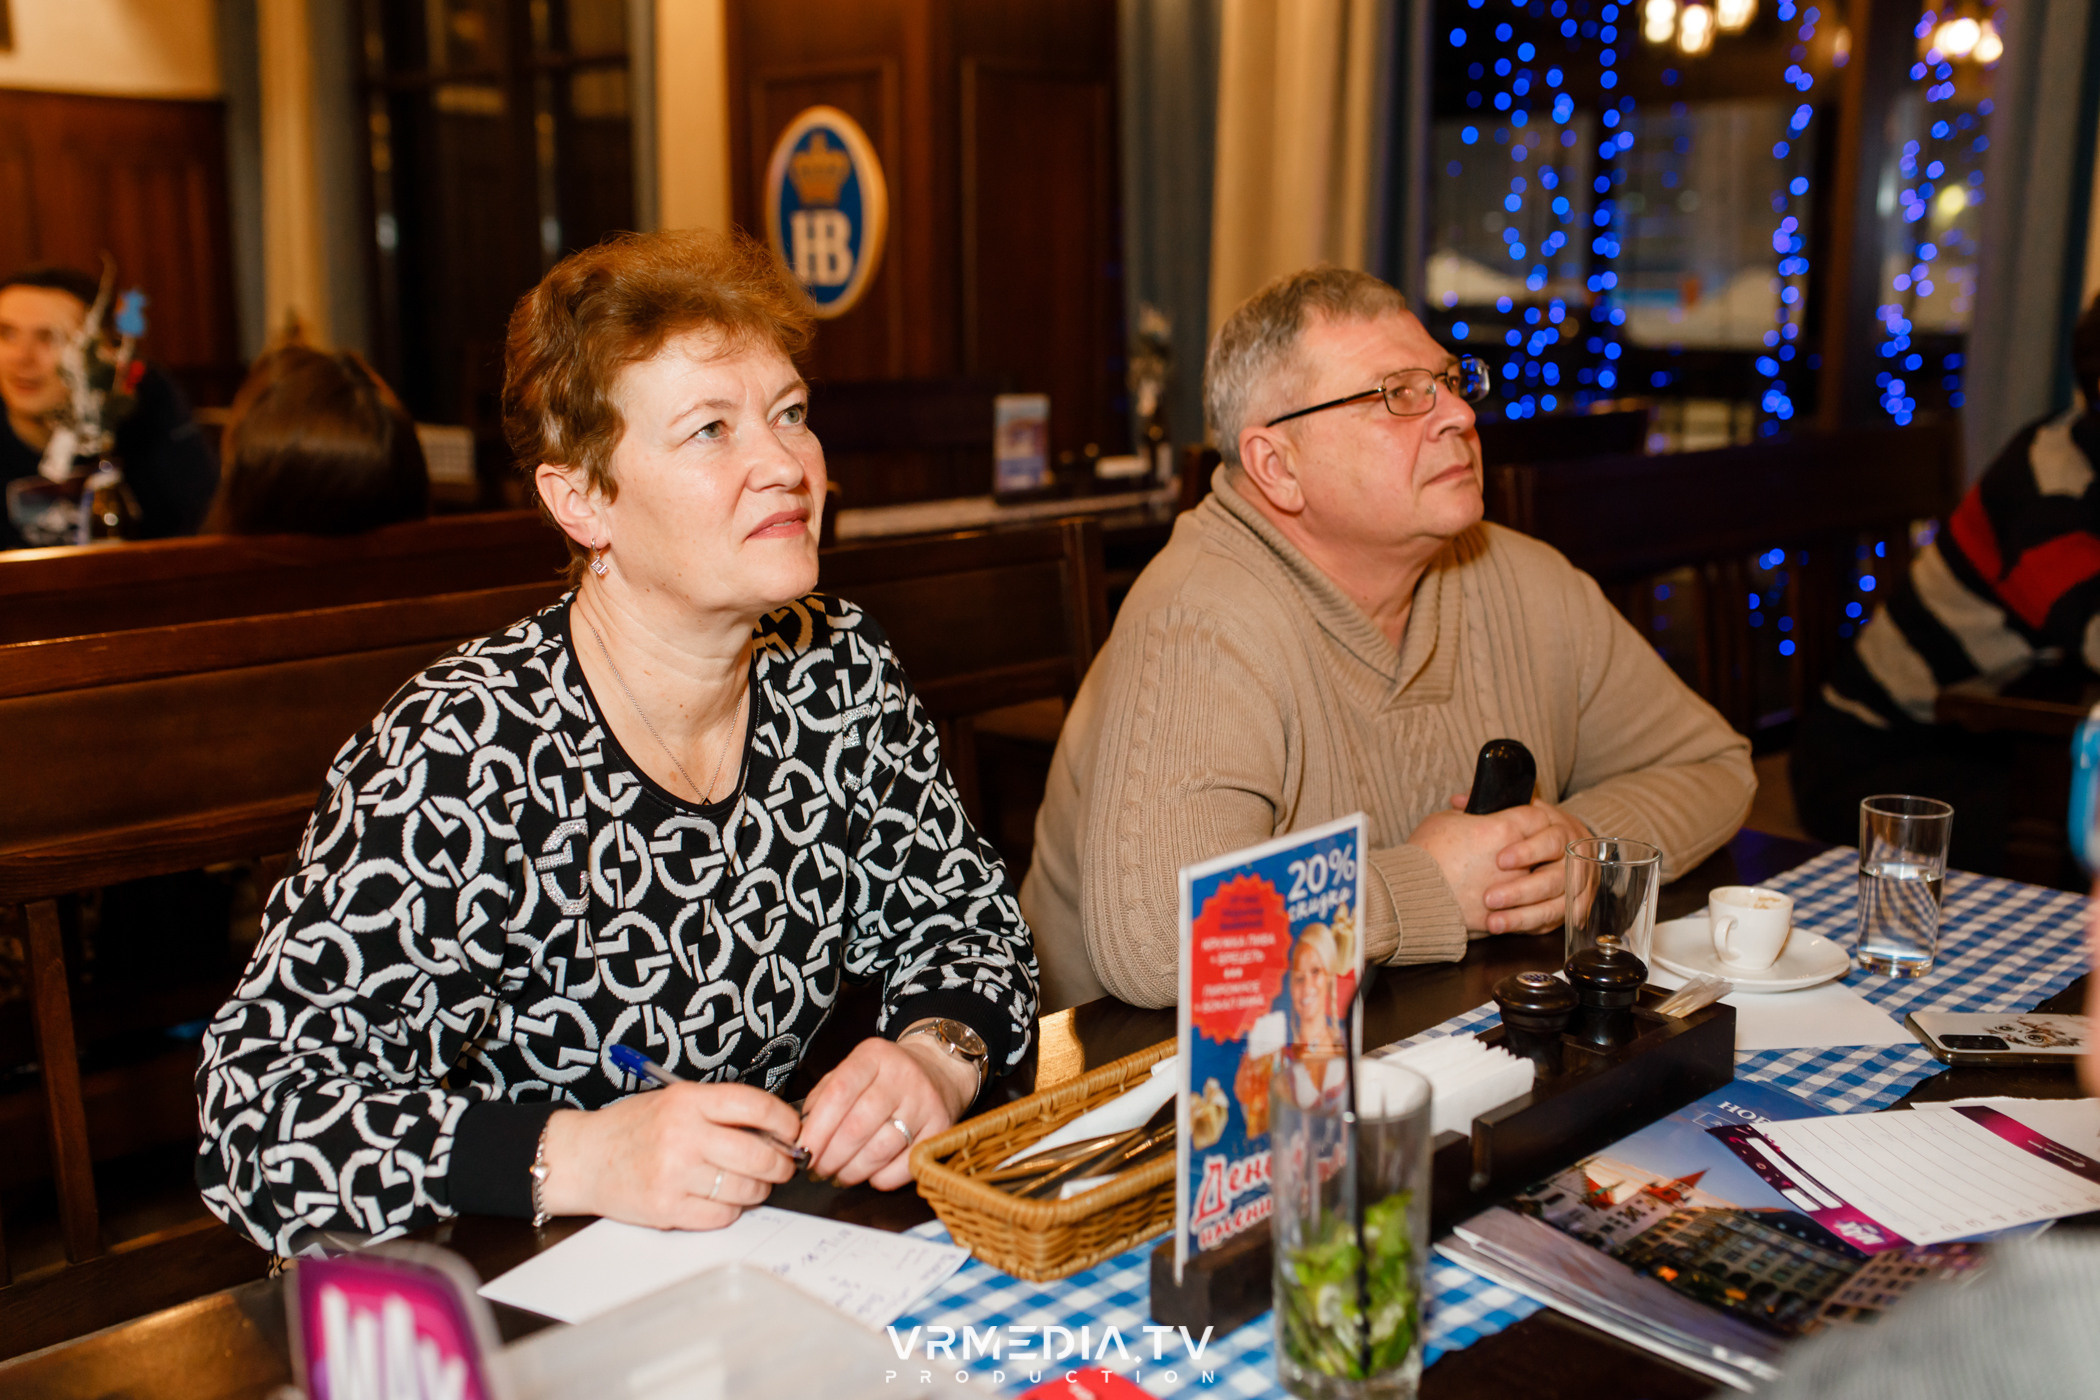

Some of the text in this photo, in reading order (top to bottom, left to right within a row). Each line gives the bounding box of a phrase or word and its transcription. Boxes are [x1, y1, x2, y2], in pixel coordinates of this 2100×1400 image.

[791, 212, 853, 287] HB
[1287, 843, 1356, 903] 20%
[1287, 887, 1353, 922] скидка
[1201, 1197, 1272, 1249] имени
